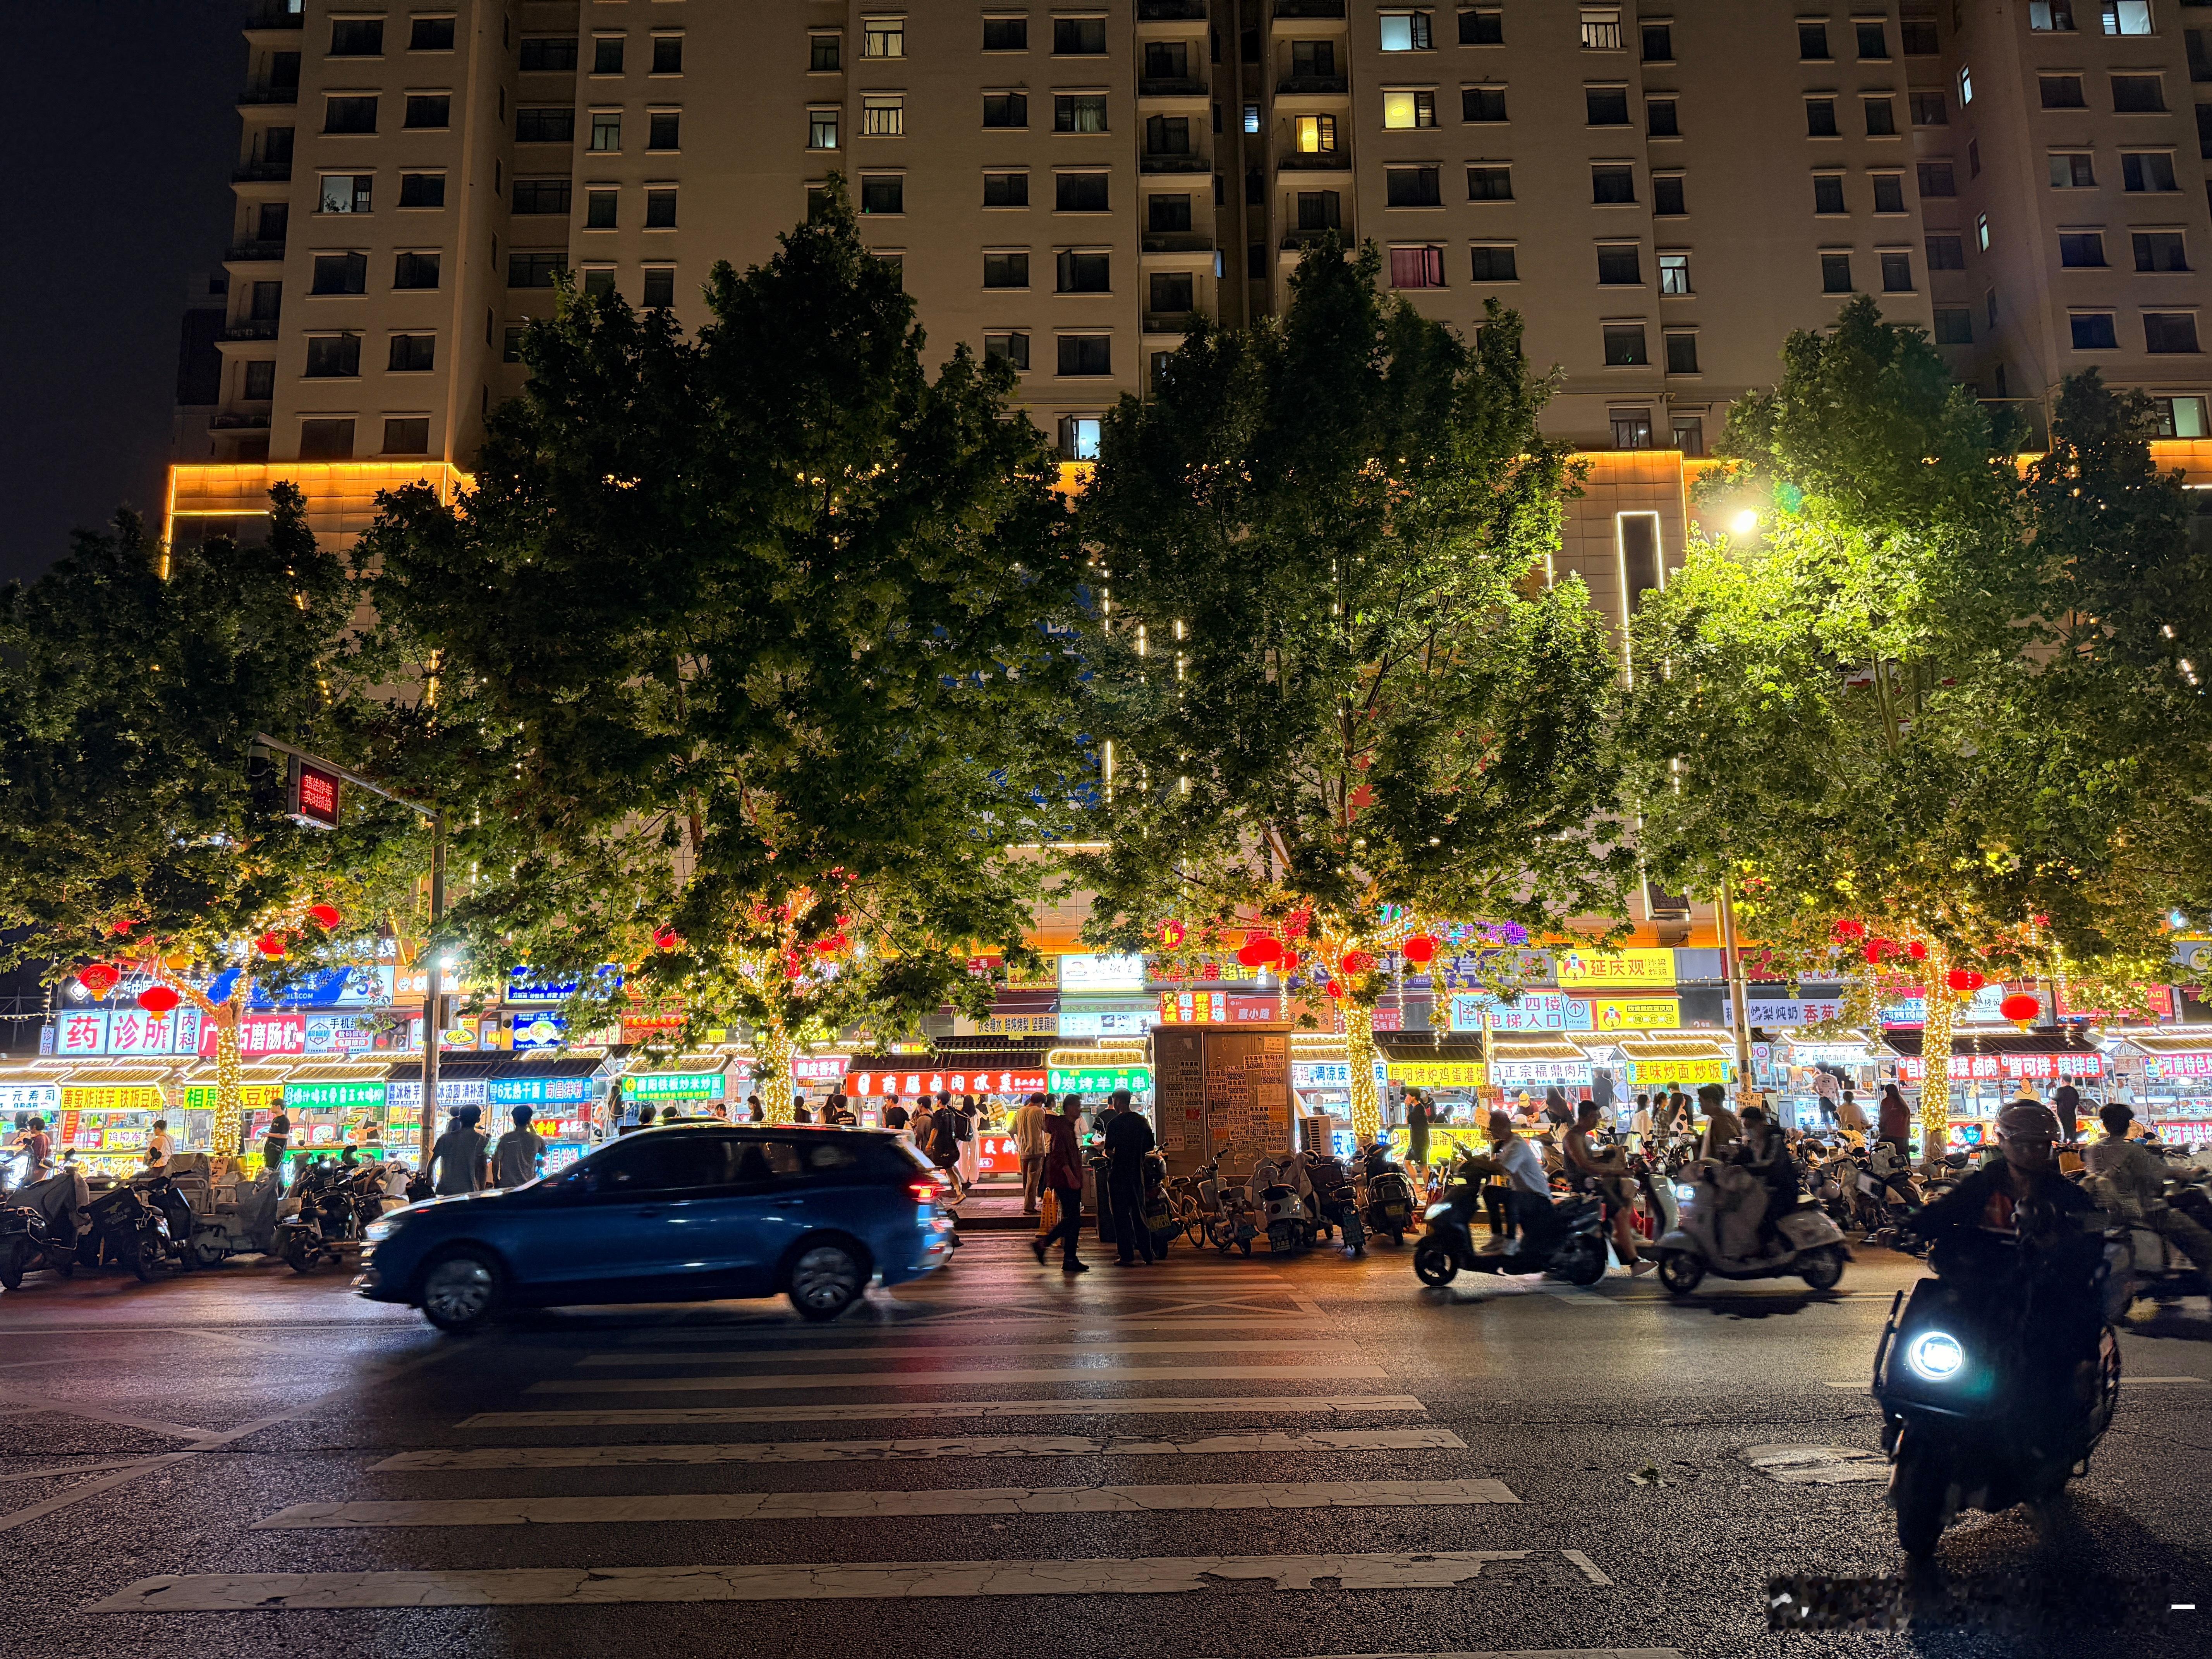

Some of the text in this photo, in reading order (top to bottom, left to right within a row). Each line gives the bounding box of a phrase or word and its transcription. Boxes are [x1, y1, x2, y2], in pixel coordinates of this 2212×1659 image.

[304, 775, 333, 797] 违法停车
[303, 790, 332, 813] 实时抓拍
[1591, 959, 1645, 976] 延庆观
[1195, 993, 1209, 1022] 鲜花店
[1211, 993, 1225, 1022] 商场
[1373, 1020, 1396, 1030] 5毛起
[1490, 1014, 1562, 1028] 电梯入口
[66, 1015, 170, 1050] 药 诊所
[179, 1013, 196, 1050] 内科
[201, 1021, 297, 1050] 广石磨肠粉
[41, 1029, 52, 1054] 诊所
[1316, 1066, 1347, 1081] 调凉皮
[1390, 1066, 1486, 1083] 信阳烤炉鸡蛋灌饼
[1504, 1064, 1589, 1078] 正宗福鼎肉片
[1635, 1063, 1722, 1081] 美味炒面 炒饭
[497, 1079, 583, 1100] 6元热干面 南昌拌粉
[1061, 1076, 1146, 1091] 炭烤羊肉串
[64, 1089, 160, 1108] 黄金炸洋芋 铁板豆腐
[187, 1087, 280, 1106] 相思豆饼
